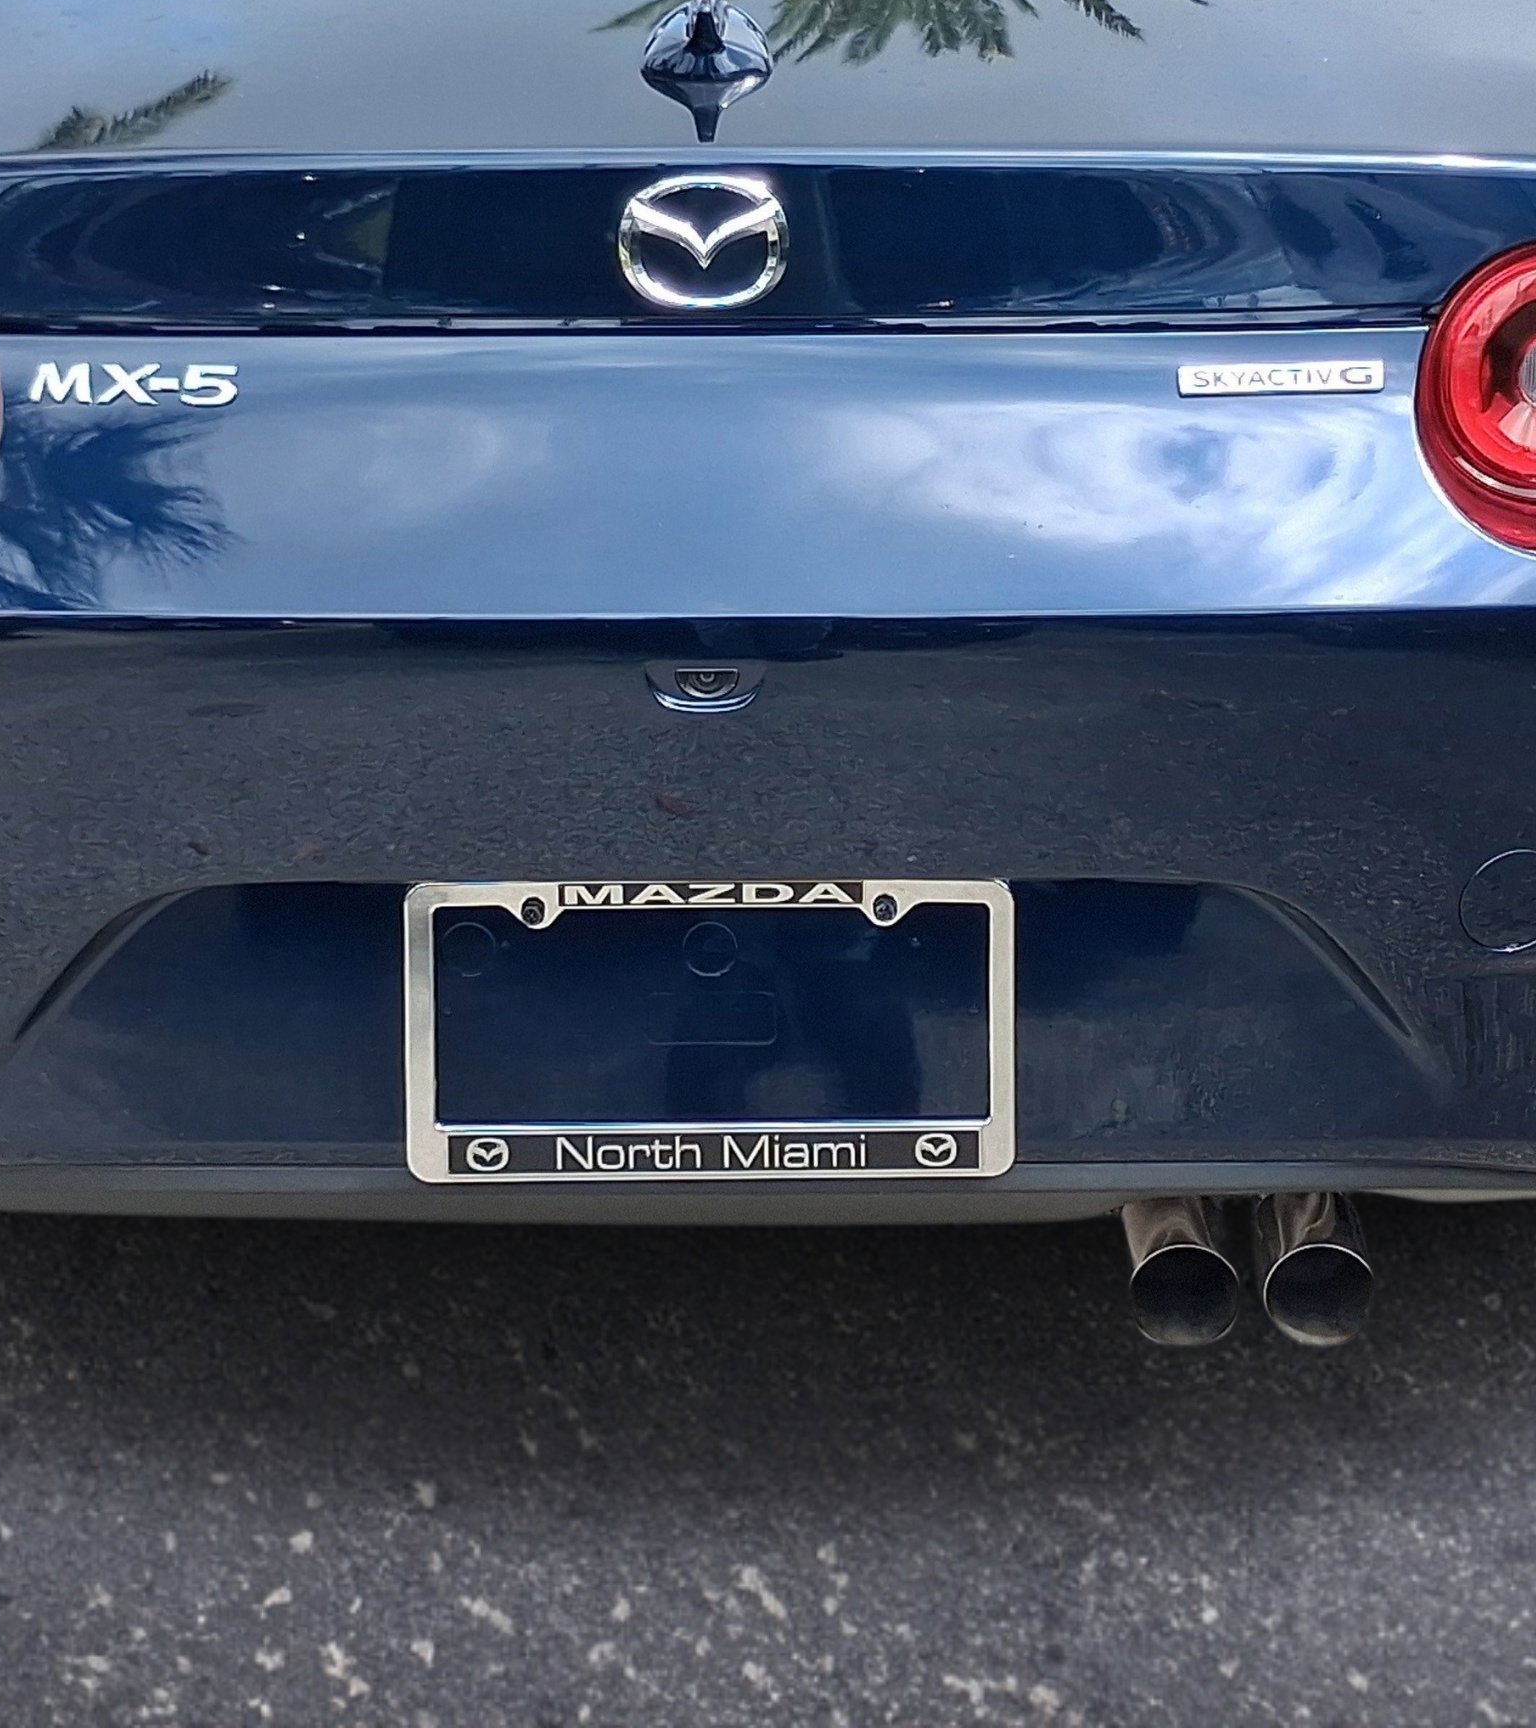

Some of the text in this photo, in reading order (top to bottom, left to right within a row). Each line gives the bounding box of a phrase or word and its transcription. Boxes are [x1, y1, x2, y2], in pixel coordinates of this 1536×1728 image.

[28, 361, 239, 407] MX-5
[563, 882, 857, 905] MAZDA
[555, 1132, 867, 1171] North Miami
